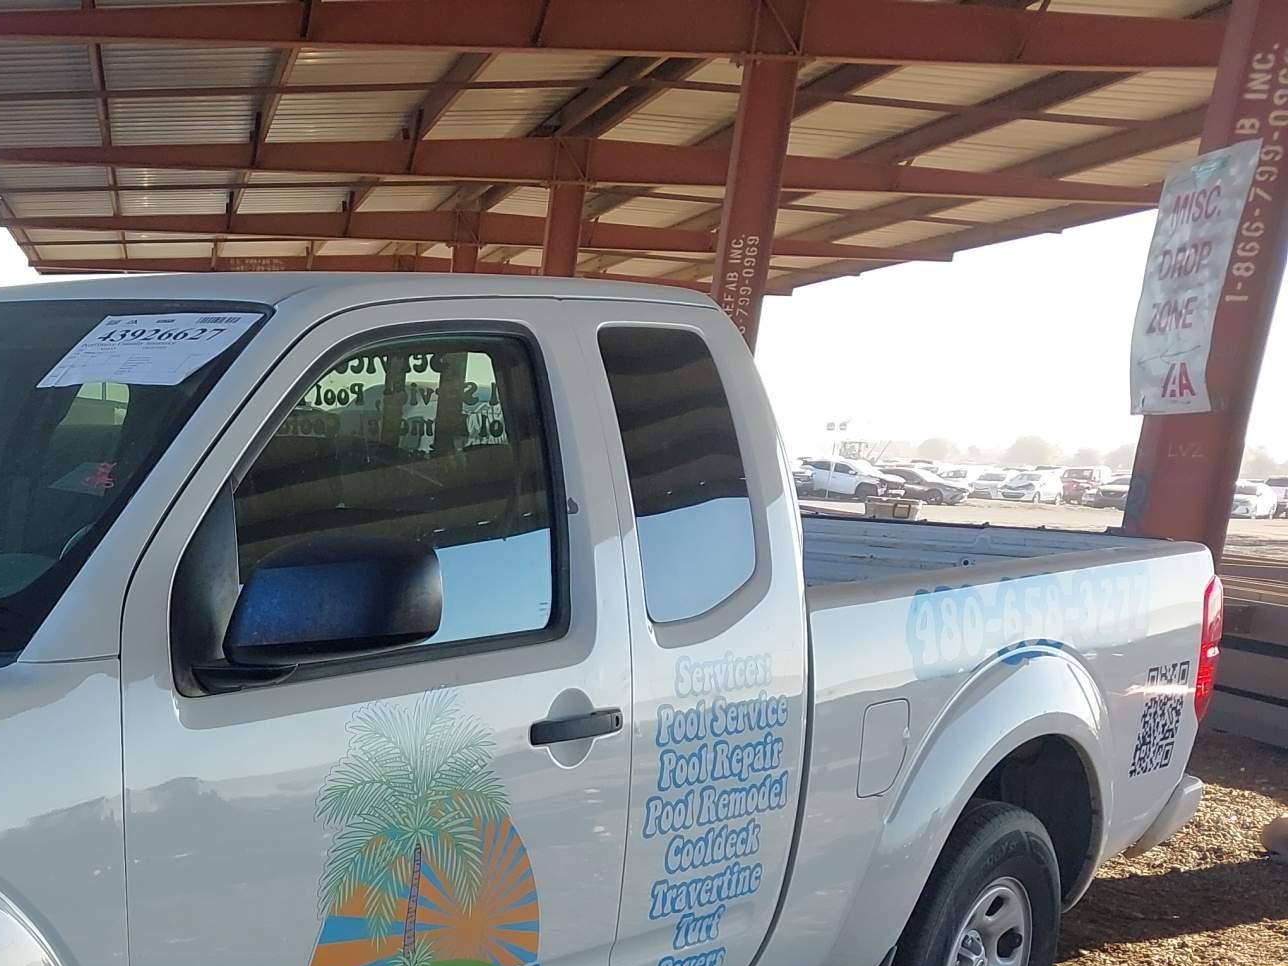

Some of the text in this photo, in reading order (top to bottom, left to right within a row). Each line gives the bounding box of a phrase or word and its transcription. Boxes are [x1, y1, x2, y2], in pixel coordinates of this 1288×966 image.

[1170, 185, 1222, 233] MISC.
[728, 233, 746, 263] INC.
[1159, 240, 1212, 280] DROP
[98, 327, 227, 342] 43926627
[1145, 296, 1197, 334] ZONE
[656, 690, 788, 746] Pool Service
[658, 732, 784, 791] Pool Repair
[643, 770, 788, 838] Pool Remodel
[665, 818, 761, 874] Cooldeck
[649, 862, 762, 919] Travertine
[673, 904, 726, 949] Turf
